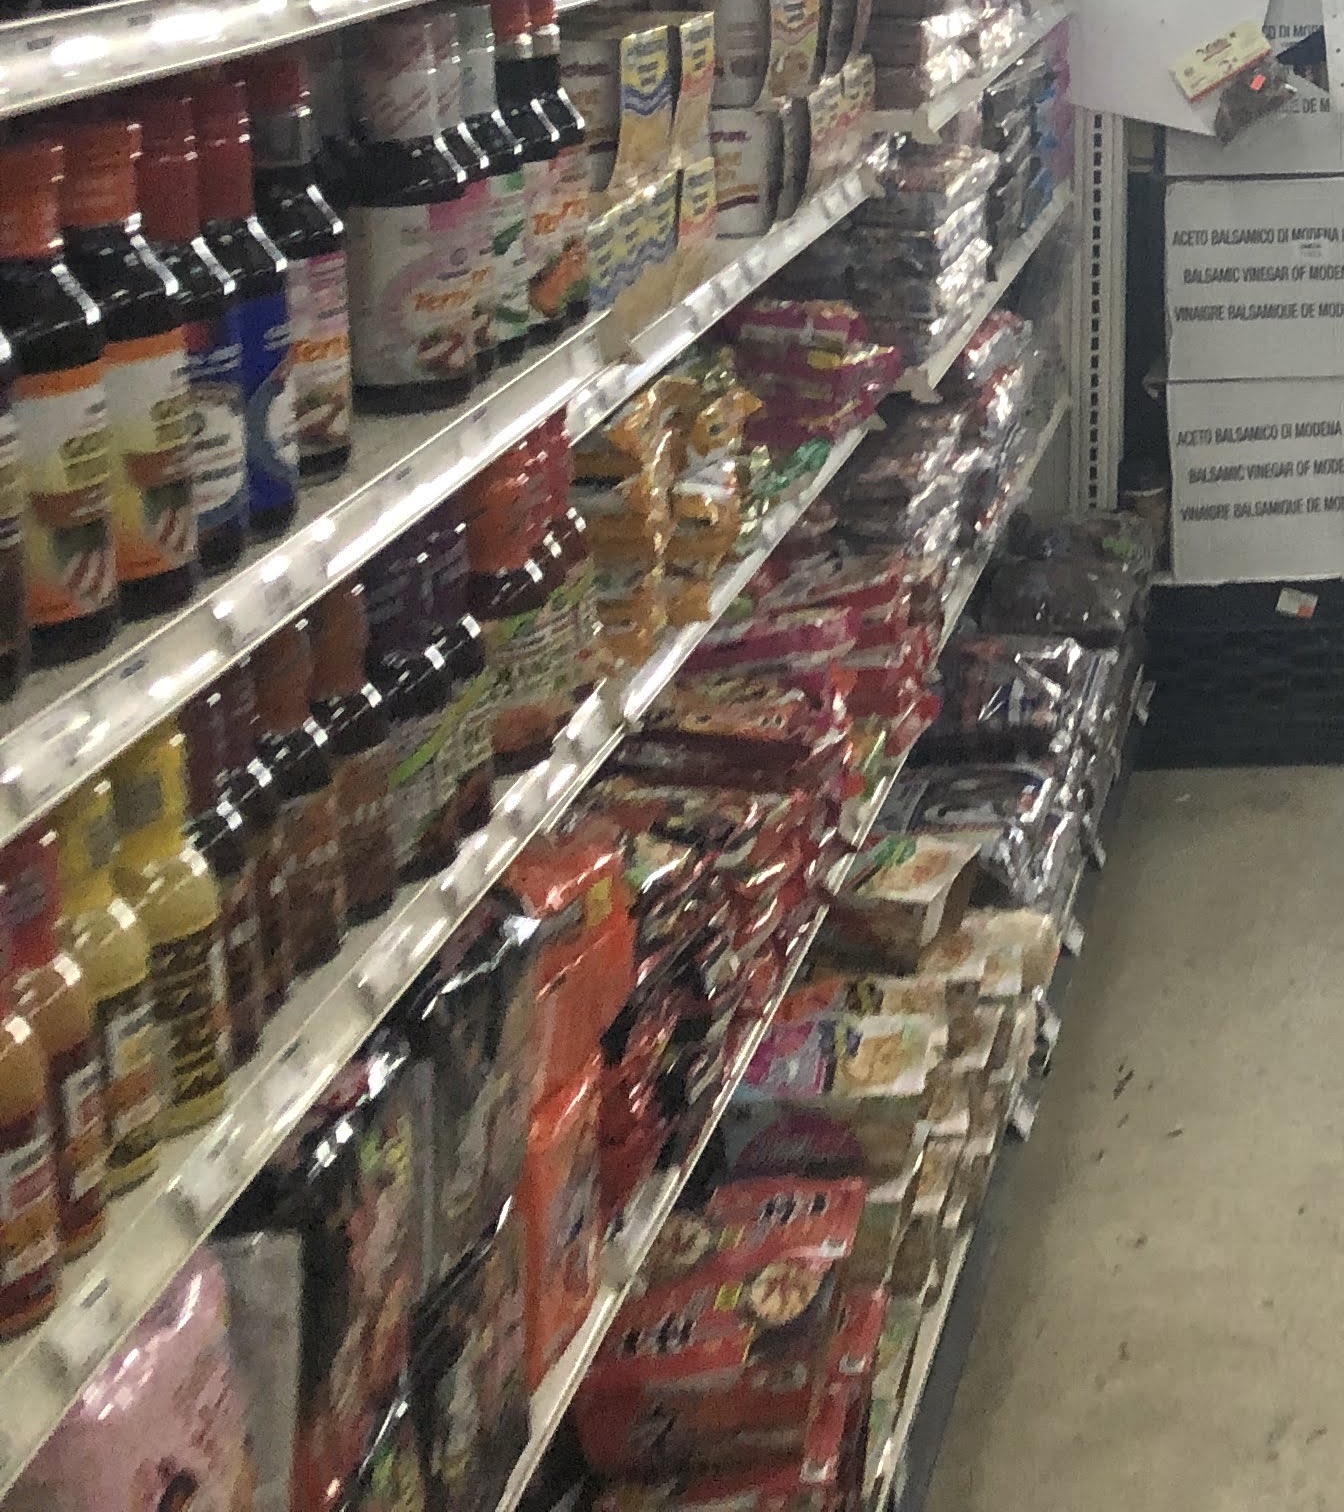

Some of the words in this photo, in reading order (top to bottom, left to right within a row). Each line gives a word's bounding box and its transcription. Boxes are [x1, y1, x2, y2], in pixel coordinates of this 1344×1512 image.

[1172, 230, 1208, 247] ACETO
[1211, 228, 1275, 246] BALSAMICO
[1277, 228, 1289, 243] DI
[1291, 227, 1340, 243] MODENA
[1183, 267, 1240, 285] BALSAMIC
[1243, 265, 1290, 283] VINEGAR
[1292, 265, 1305, 281] OF
[1174, 305, 1225, 322] VINAIGRE
[1228, 303, 1298, 321] BALSAMIQUE
[1301, 302, 1316, 319] DE
[1177, 429, 1212, 447] ACETO
[1214, 425, 1278, 444] BALSAMICO
[1281, 423, 1292, 439] DI
[1294, 420, 1342, 438] MODENA
[1188, 465, 1245, 485] BALSAMIC
[1247, 461, 1294, 480] VINEGAR
[1296, 460, 1310, 477] OF
[1180, 503, 1230, 522] VINAIGRE
[1233, 498, 1304, 518] BALSAMIQUE
[1306, 497, 1322, 513] DE
